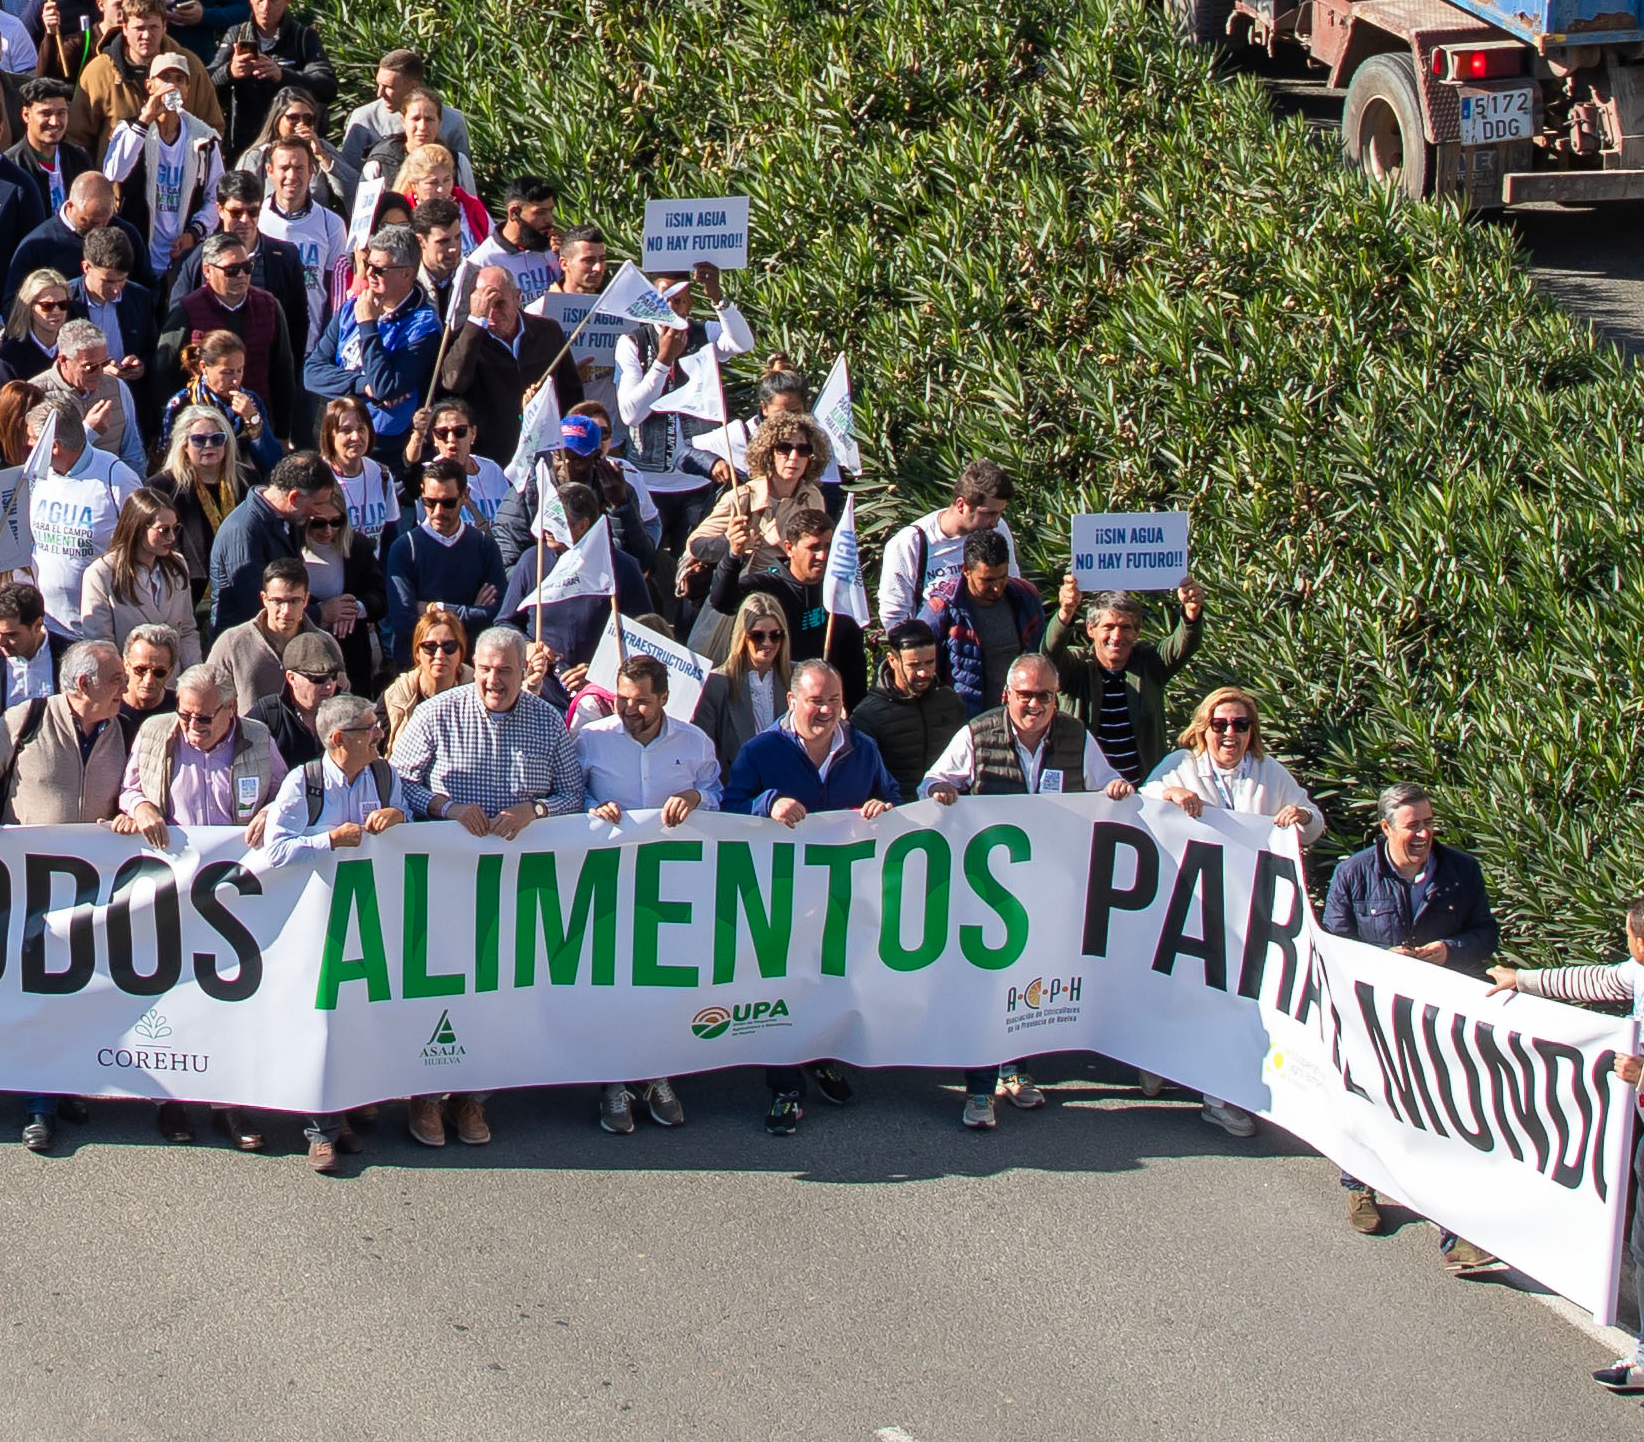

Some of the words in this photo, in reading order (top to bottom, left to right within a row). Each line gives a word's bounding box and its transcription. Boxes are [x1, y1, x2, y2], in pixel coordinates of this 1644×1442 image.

[1475, 90, 1528, 117] 5172
[1483, 118, 1521, 139] DDG
[665, 213, 692, 228] ¡¡SIN
[697, 211, 726, 226] AGUA
[647, 236, 663, 251] NO
[667, 235, 689, 250] HAY
[692, 233, 743, 249] FUTURO!!
[35, 499, 94, 527] AGUA
[63, 525, 94, 539] CAMPO
[1095, 528, 1126, 544] ¡¡SIN
[1130, 527, 1164, 544] AGUA
[62, 546, 94, 557] MUNDO
[1075, 553, 1093, 570] NO
[1097, 552, 1122, 569] HAY
[1126, 550, 1183, 568] FUTURO!!
[315, 823, 1031, 1009] ALIMENTOS
[732, 999, 790, 1022] UPA
[97, 1047, 210, 1073] COREHU
[418, 1044, 466, 1059] ASAJA
[423, 1056, 461, 1067] HUELVA
